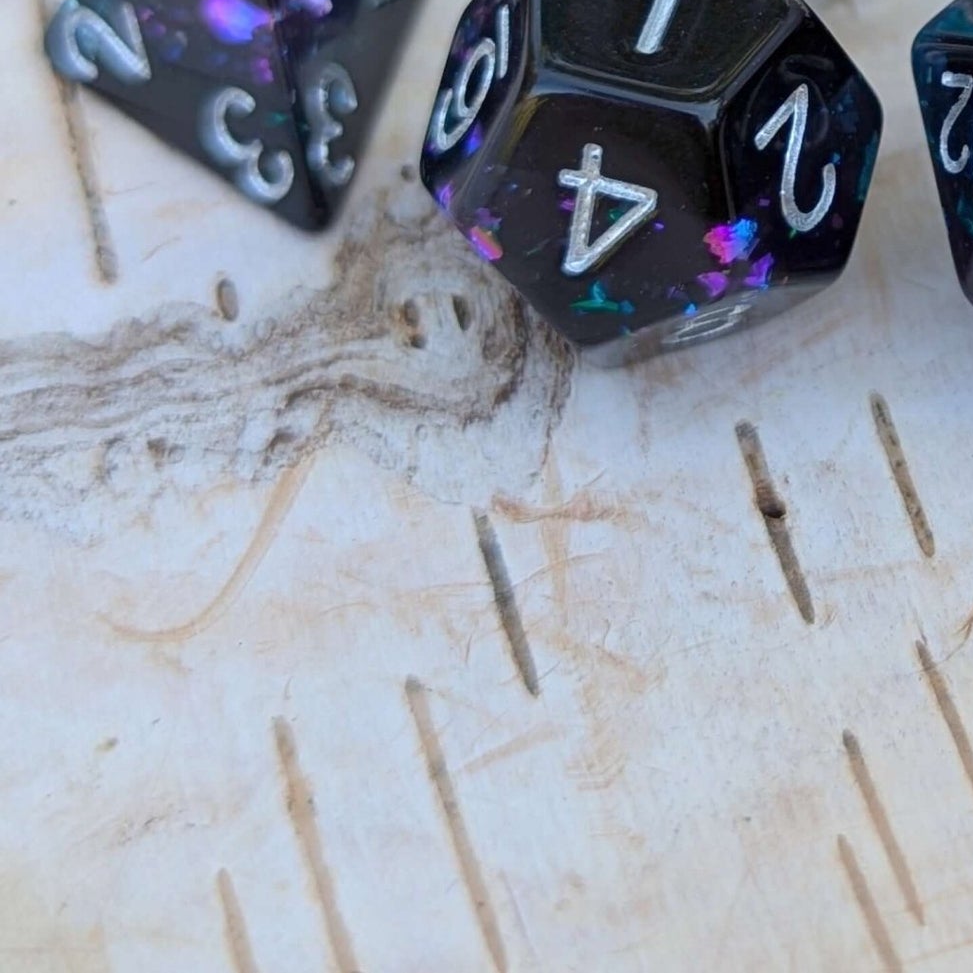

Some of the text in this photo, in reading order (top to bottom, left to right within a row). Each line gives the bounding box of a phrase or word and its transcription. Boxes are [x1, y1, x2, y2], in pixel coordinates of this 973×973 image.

[44, 2, 151, 84] 2
[200, 85, 294, 205] 3
[306, 61, 358, 186] 3
[753, 83, 836, 232] 2
[558, 143, 657, 277] 4
